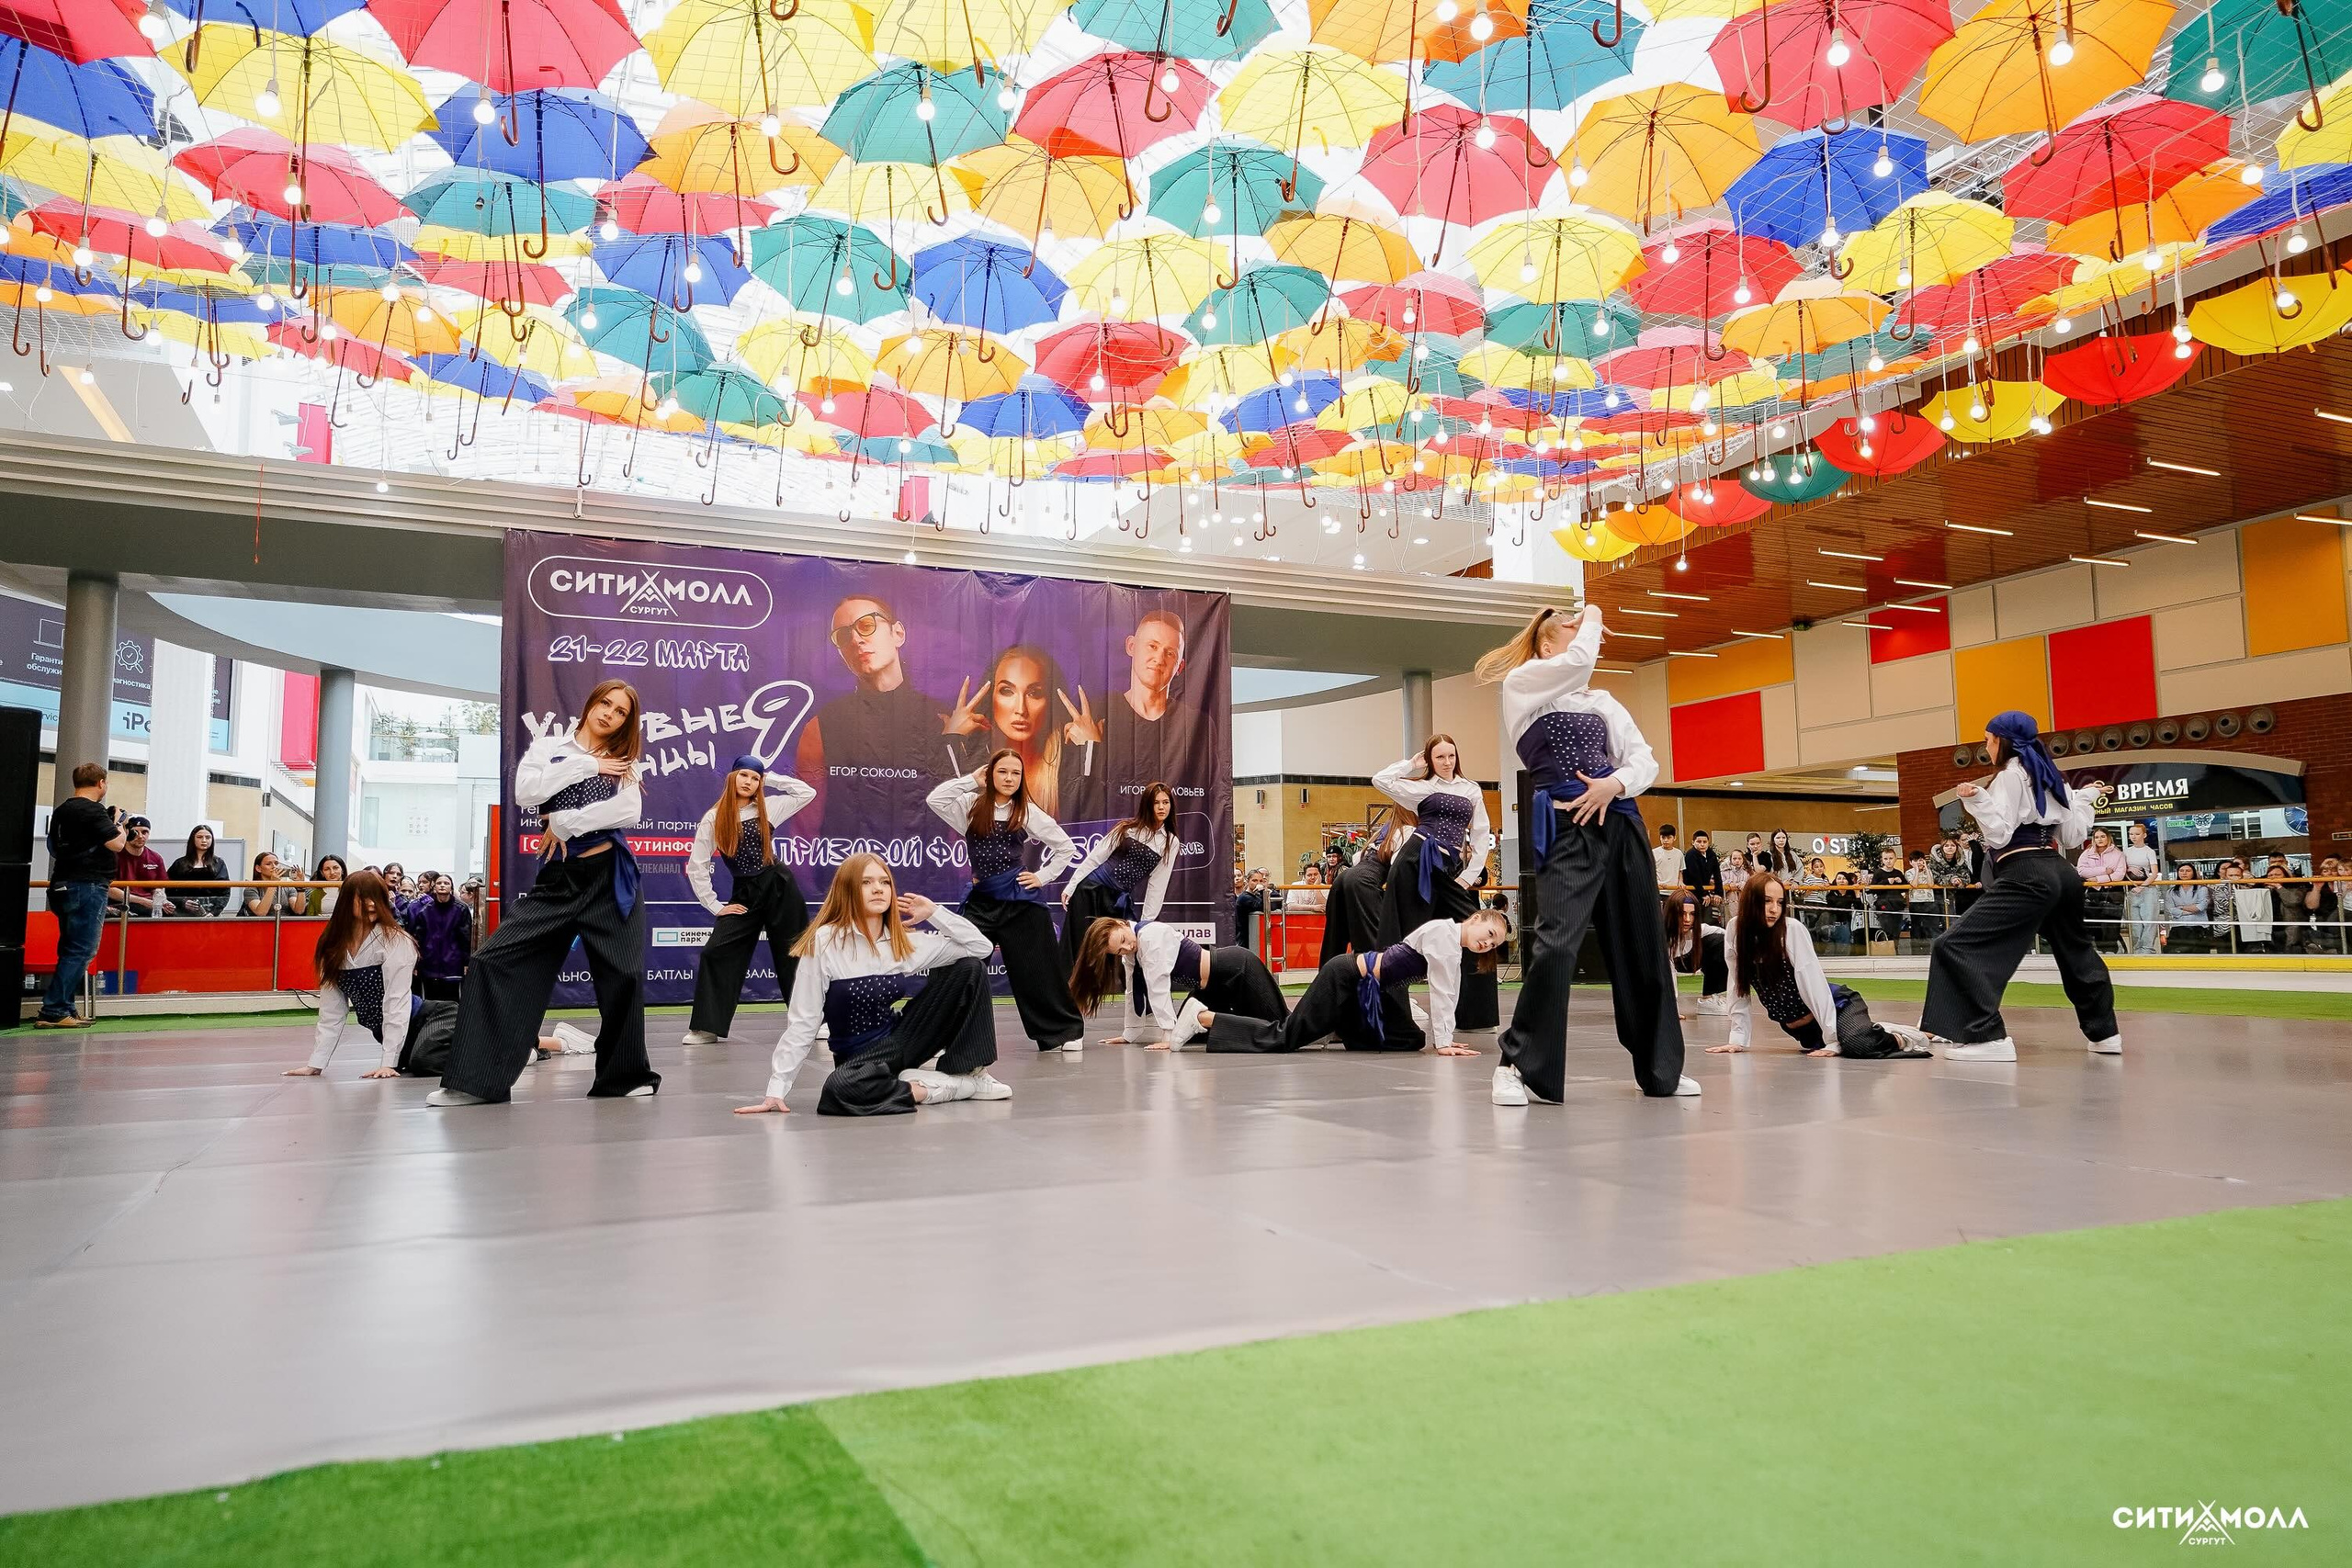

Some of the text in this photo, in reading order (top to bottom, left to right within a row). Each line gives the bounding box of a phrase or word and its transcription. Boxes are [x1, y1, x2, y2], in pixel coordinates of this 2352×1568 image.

[550, 570, 637, 595] СИТИ
[630, 605, 670, 616] СУРГУТ
[31, 652, 63, 665] Гаранти
[548, 635, 750, 672] 21-22 МАРТА
[27, 663, 62, 675] обслужи
[830, 766, 918, 779] ЕГОР СОКОЛОВ
[1120, 785, 1205, 796] ИГОР ЛОВЬЕВ
[2118, 778, 2189, 800] ВРЕМЯ
[658, 821, 701, 832] партн
[638, 863, 681, 874] ЕЛЕКАНАЛ
[647, 969, 694, 981] БАТТЛЫ
